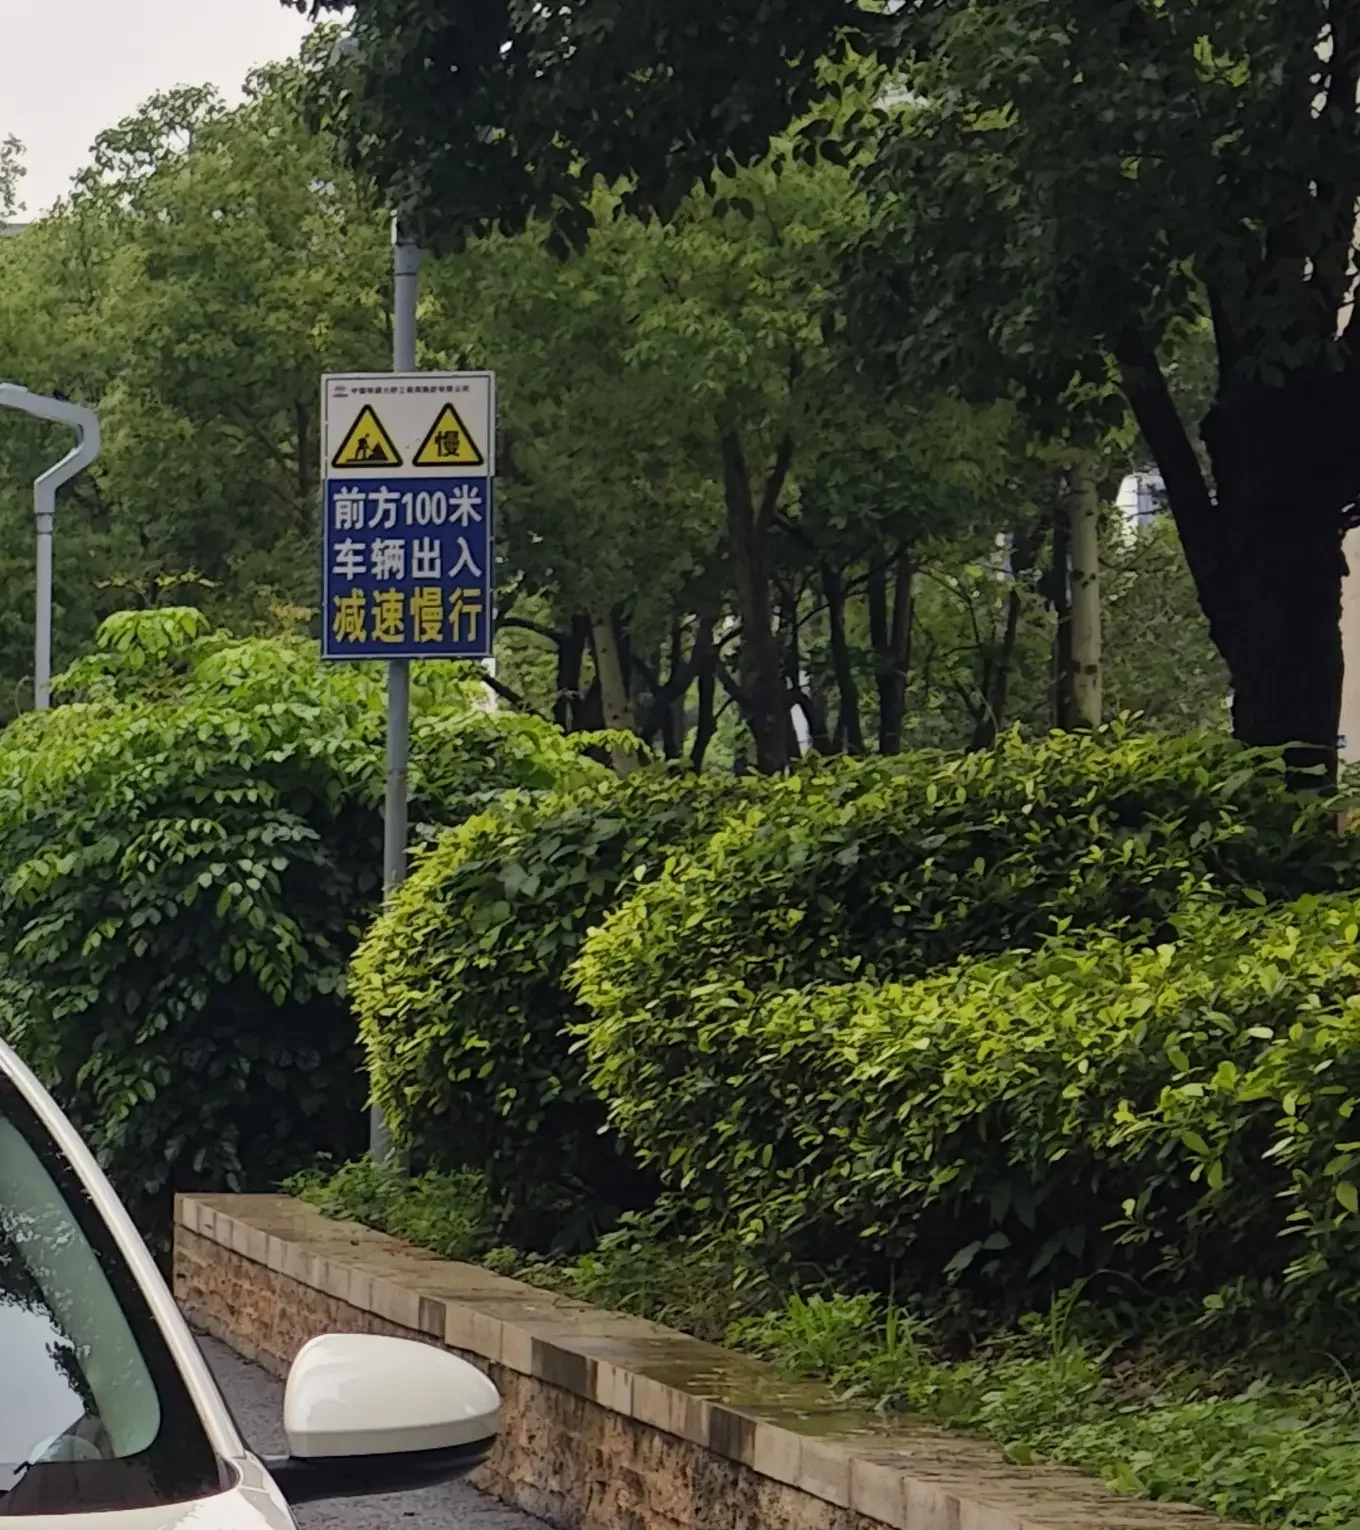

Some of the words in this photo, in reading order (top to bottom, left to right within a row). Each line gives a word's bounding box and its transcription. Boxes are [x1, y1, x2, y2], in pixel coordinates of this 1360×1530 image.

[333, 484, 482, 530] 前方100米
[332, 537, 482, 580] 车辆出入
[332, 587, 482, 643] 减速慢行
